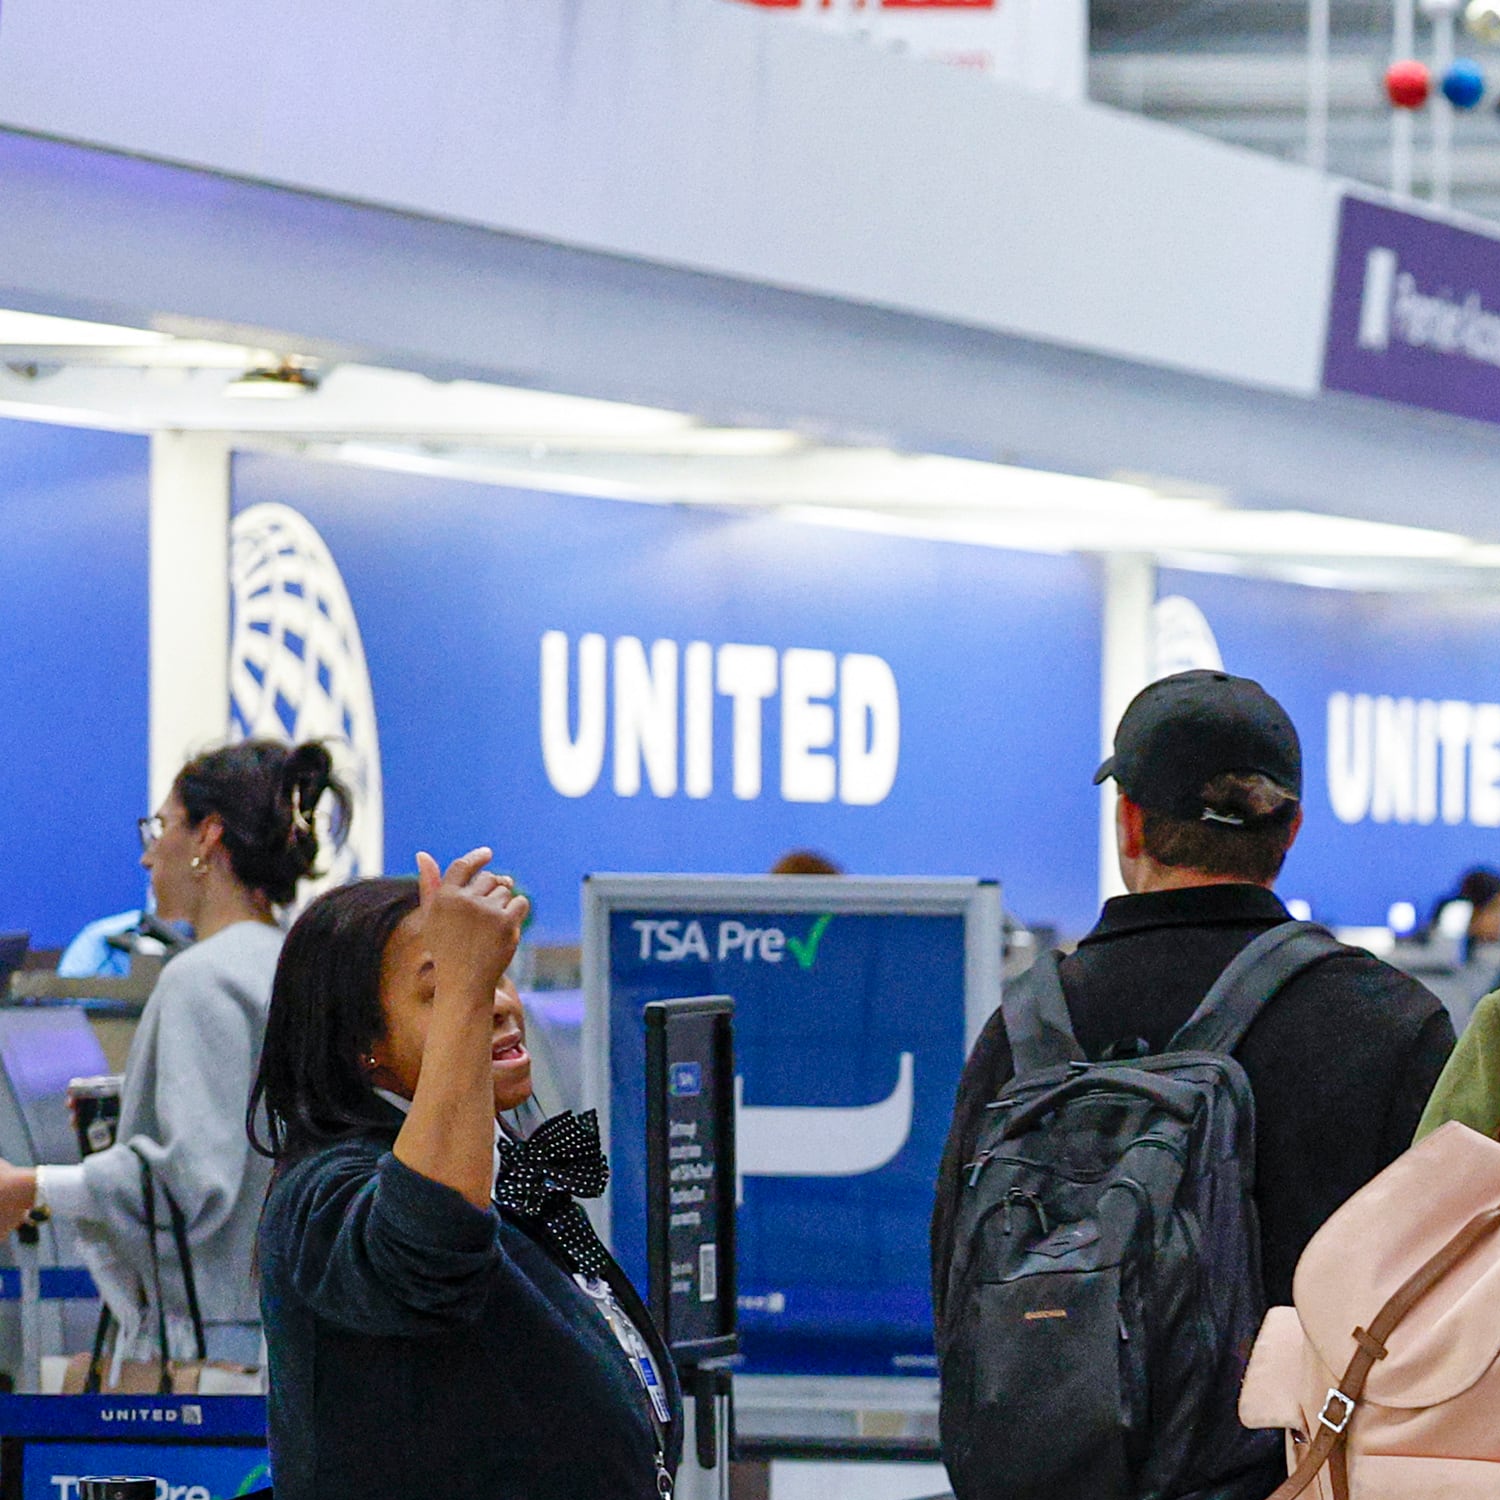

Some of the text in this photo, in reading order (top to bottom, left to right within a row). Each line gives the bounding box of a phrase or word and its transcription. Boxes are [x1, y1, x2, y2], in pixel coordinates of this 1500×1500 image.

[539, 629, 899, 806] UNITED
[633, 919, 786, 962] TSA Pre
[100, 1408, 178, 1422] UNITED
